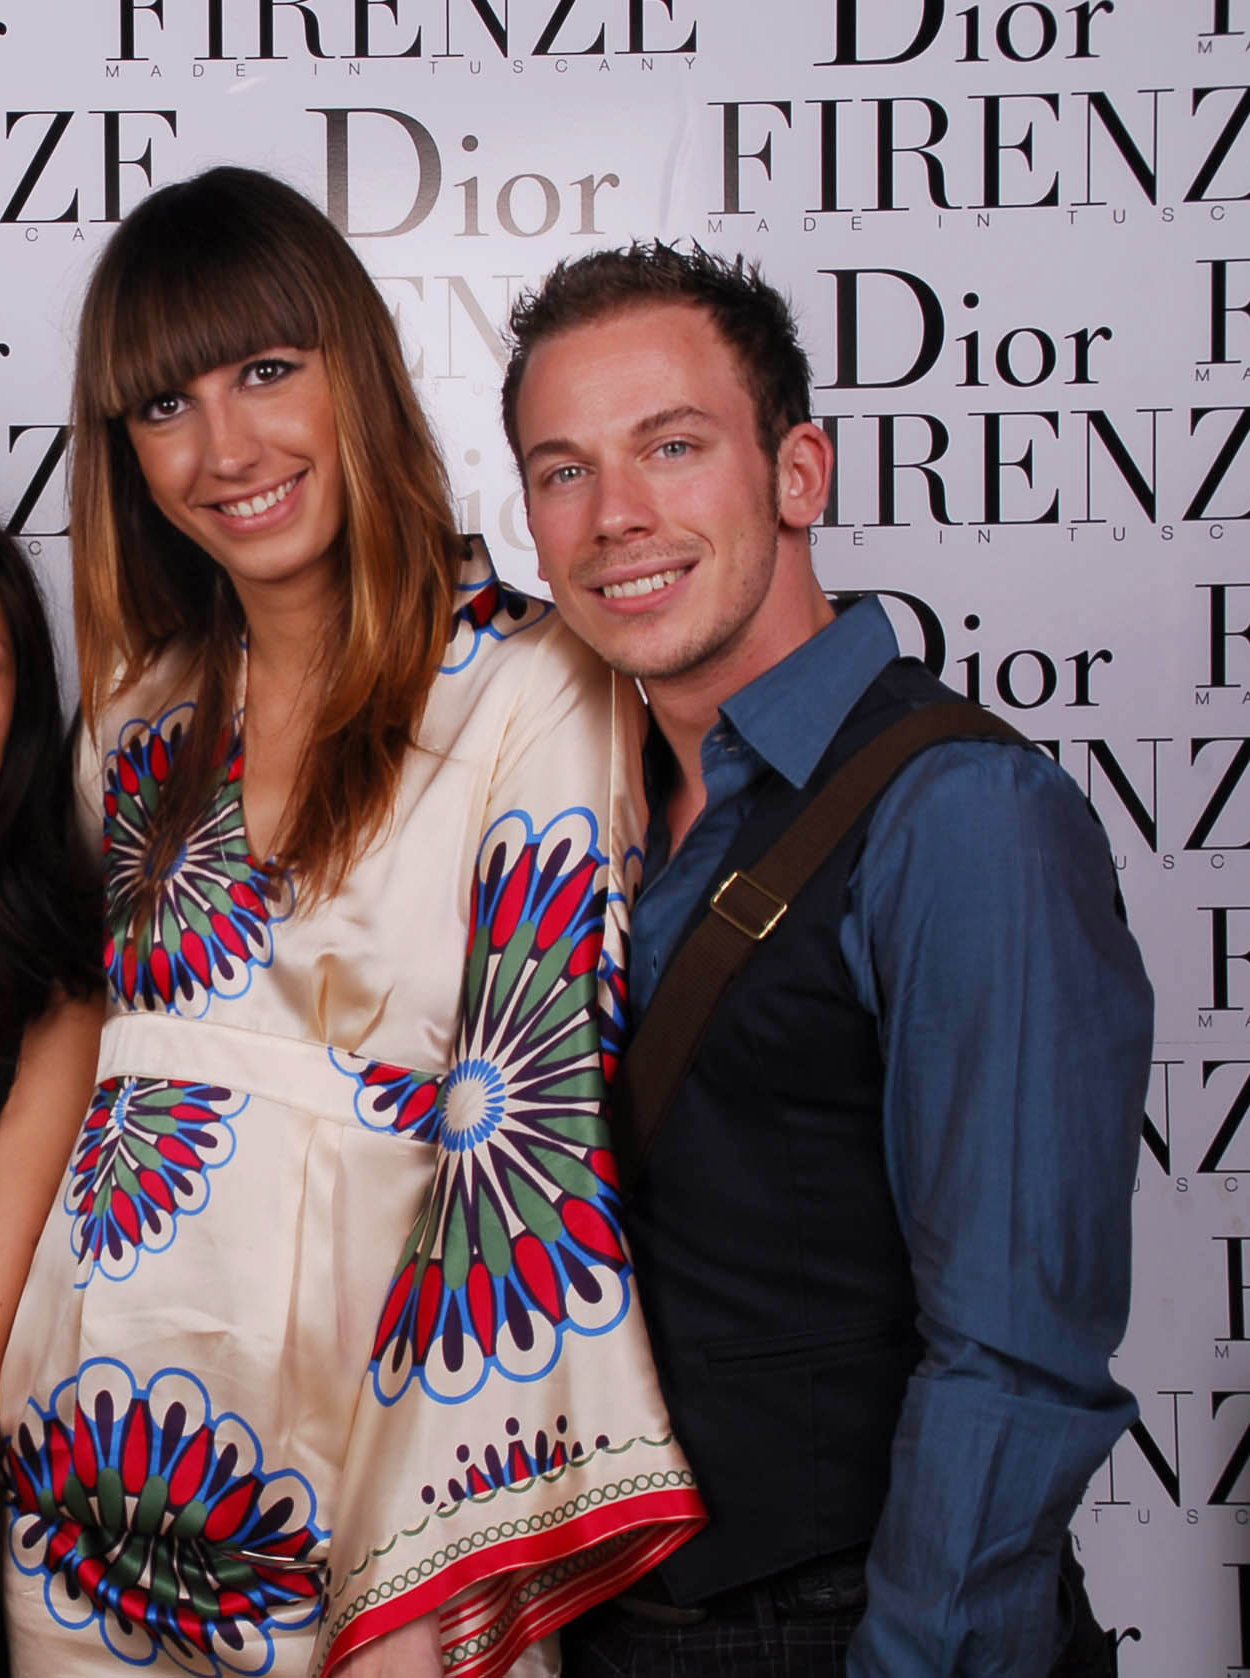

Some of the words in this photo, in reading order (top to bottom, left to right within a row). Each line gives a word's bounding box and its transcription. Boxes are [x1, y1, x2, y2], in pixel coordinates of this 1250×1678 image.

[106, 0, 698, 60] FIRENZE
[812, 0, 1114, 66] Dior
[106, 62, 246, 78] MADE
[314, 61, 361, 76] IN
[429, 57, 697, 75] TUSCANY
[305, 107, 620, 239] Dior
[707, 216, 863, 233] MADE
[938, 213, 990, 230] IN
[814, 268, 1113, 389] Dior
[939, 529, 991, 545] IN
